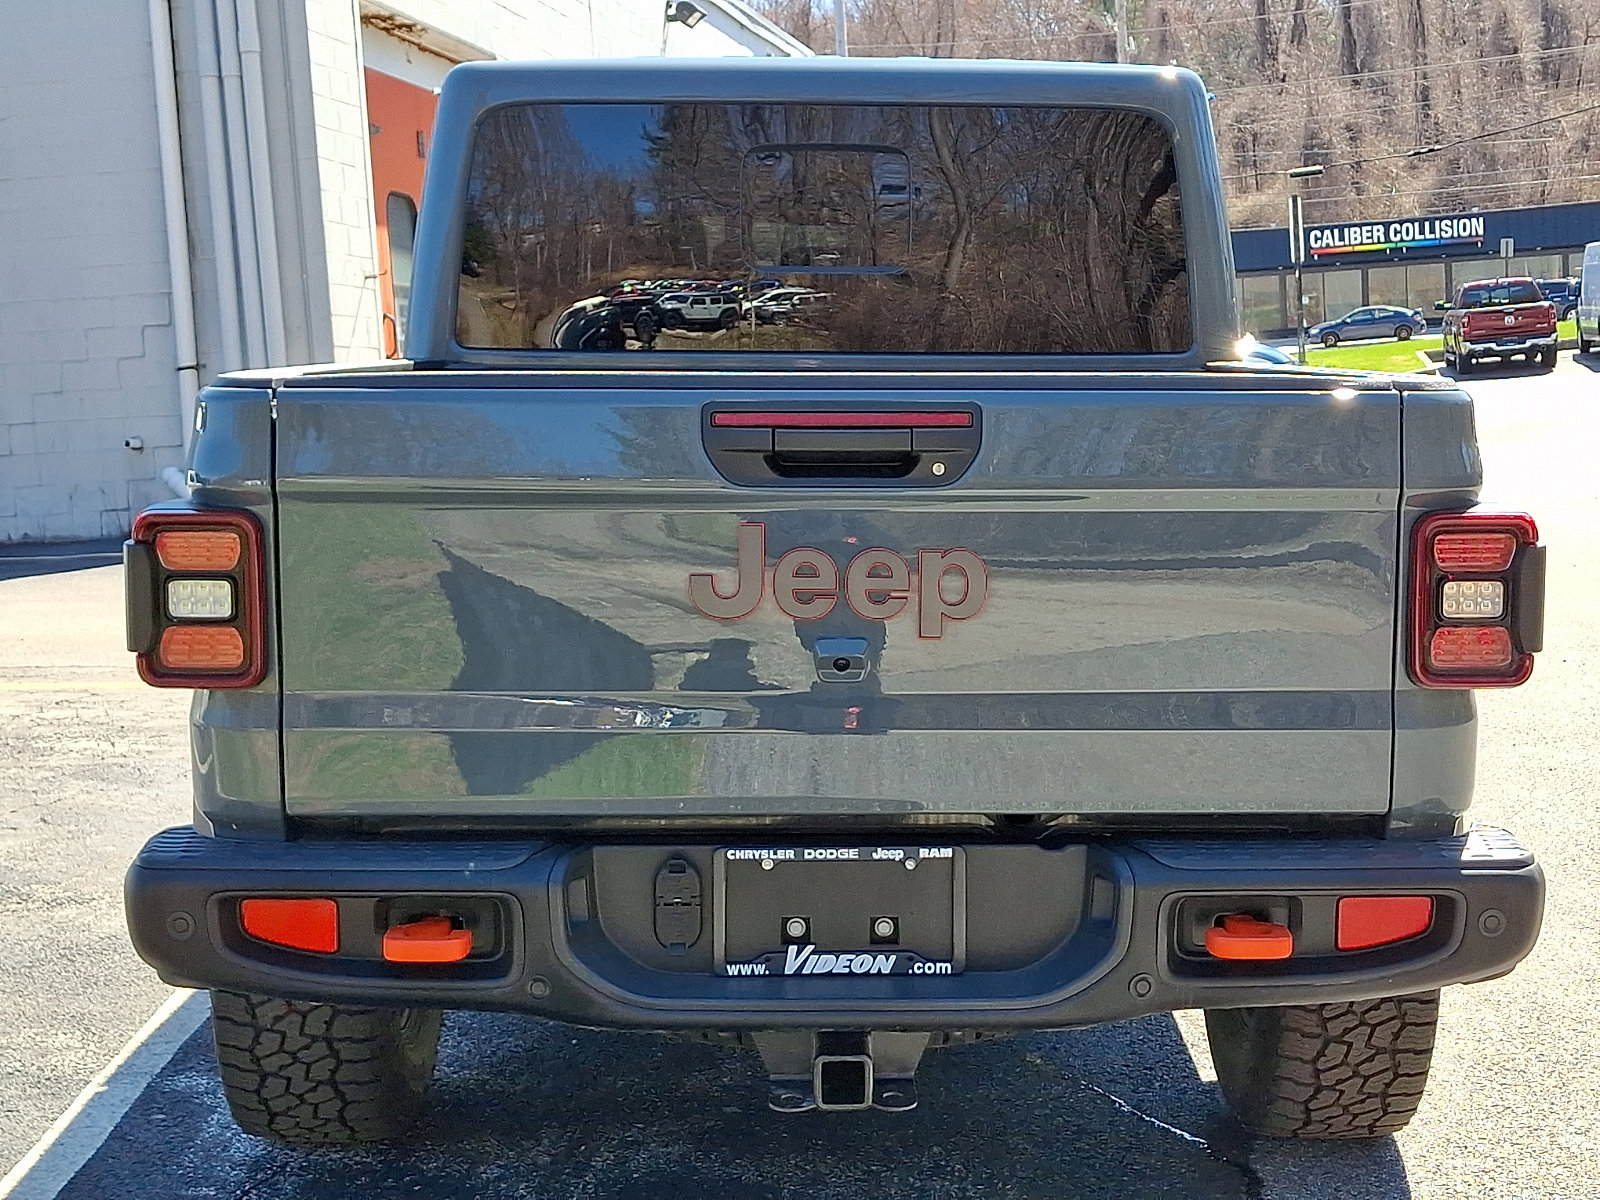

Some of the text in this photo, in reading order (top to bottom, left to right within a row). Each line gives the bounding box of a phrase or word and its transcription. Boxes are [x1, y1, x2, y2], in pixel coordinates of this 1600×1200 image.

[1309, 217, 1484, 248] CALIBER COLLISION
[688, 522, 989, 640] Jeep
[726, 848, 952, 861] CHRYSLER DODGE Jeep RAM
[726, 945, 952, 976] www. VIDEON .com
